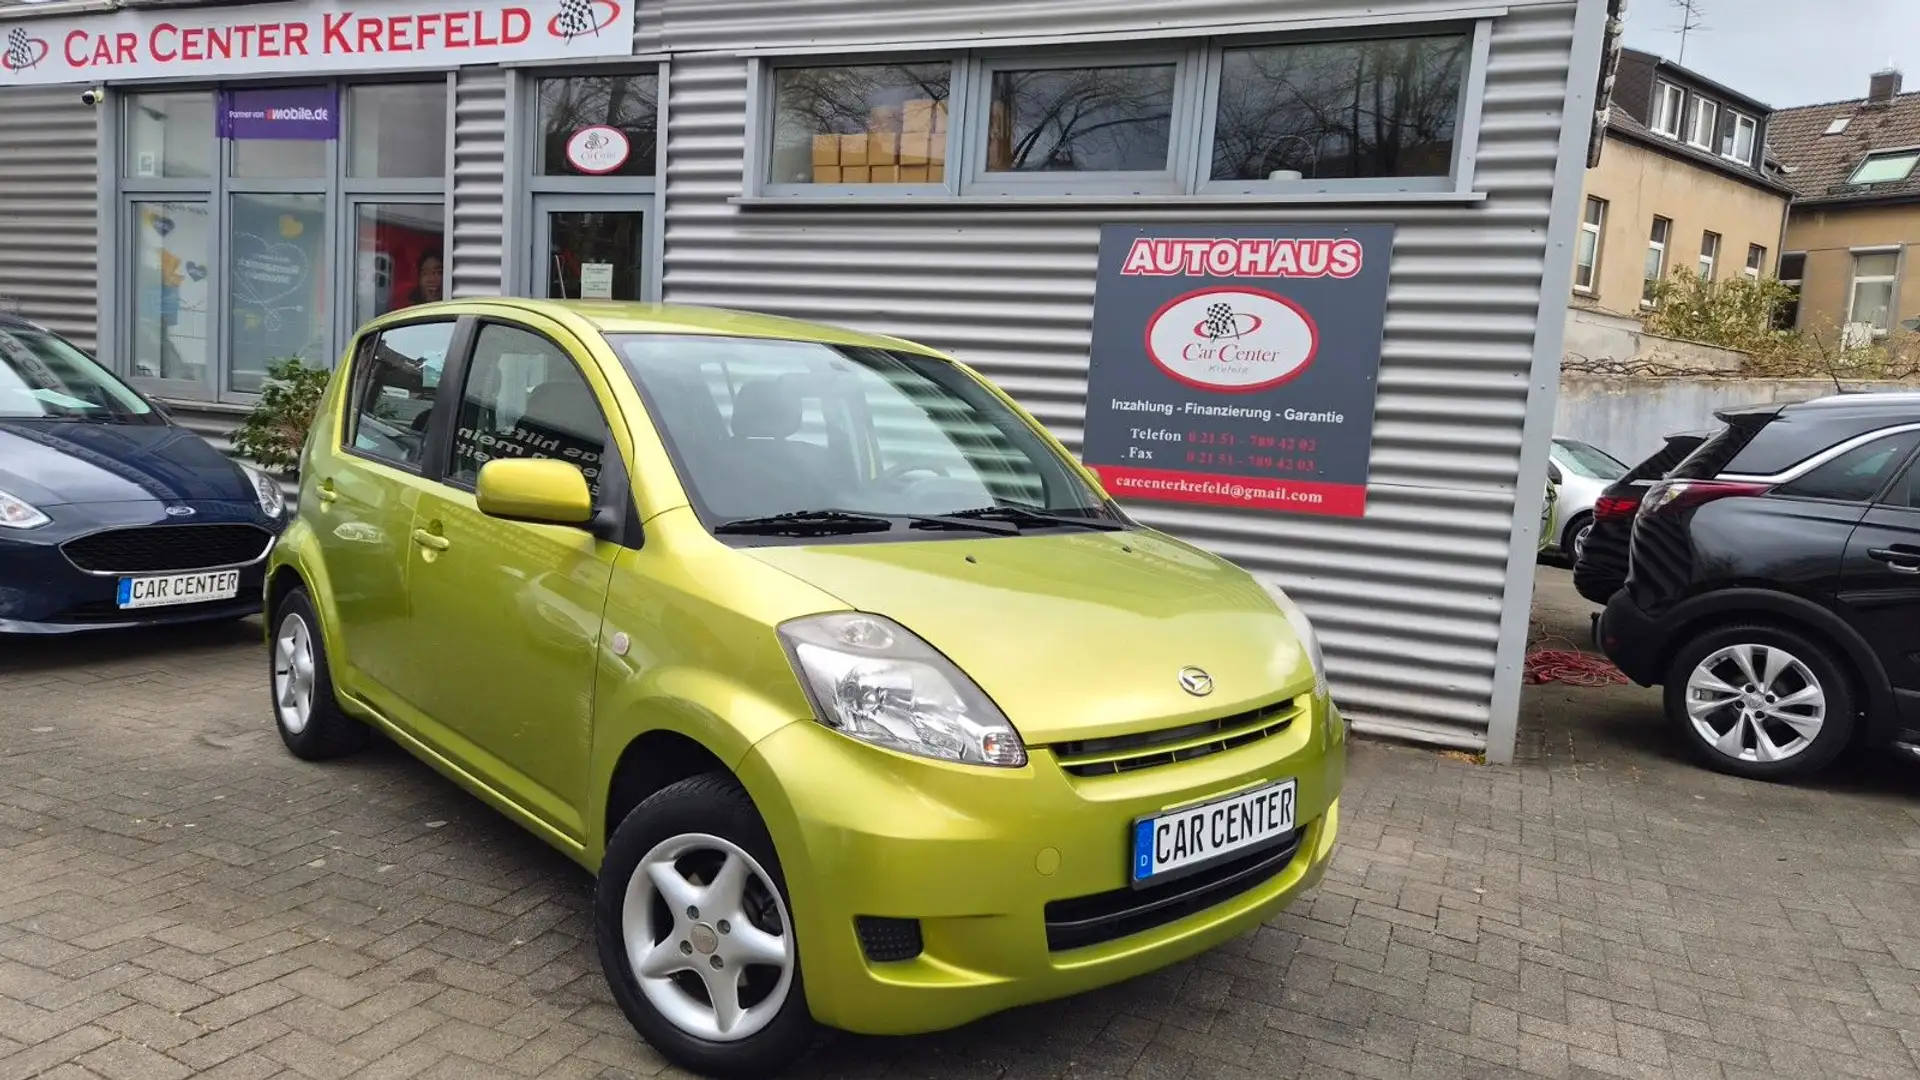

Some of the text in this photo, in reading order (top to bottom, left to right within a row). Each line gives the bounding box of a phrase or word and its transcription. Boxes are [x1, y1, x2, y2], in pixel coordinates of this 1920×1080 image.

[64, 7, 532, 67] CAR CENTER KREFELD
[229, 110, 251, 118] Partner
[1120, 238, 1363, 278] AUTOHAUS
[1182, 343, 1280, 364] Car Center
[1111, 398, 1173, 416] Inzahlung
[1184, 402, 1271, 422] Finanzierung
[1284, 408, 1344, 424] Garantie
[1130, 428, 1182, 442] Telefon
[1129, 446, 1153, 460] Fax
[1116, 475, 1323, 504] carcenterkrefeld@gmail.com
[133, 572, 237, 599] CAR CENTER
[1155, 787, 1292, 864] CAR CENTER
[1140, 854, 1148, 867] D
